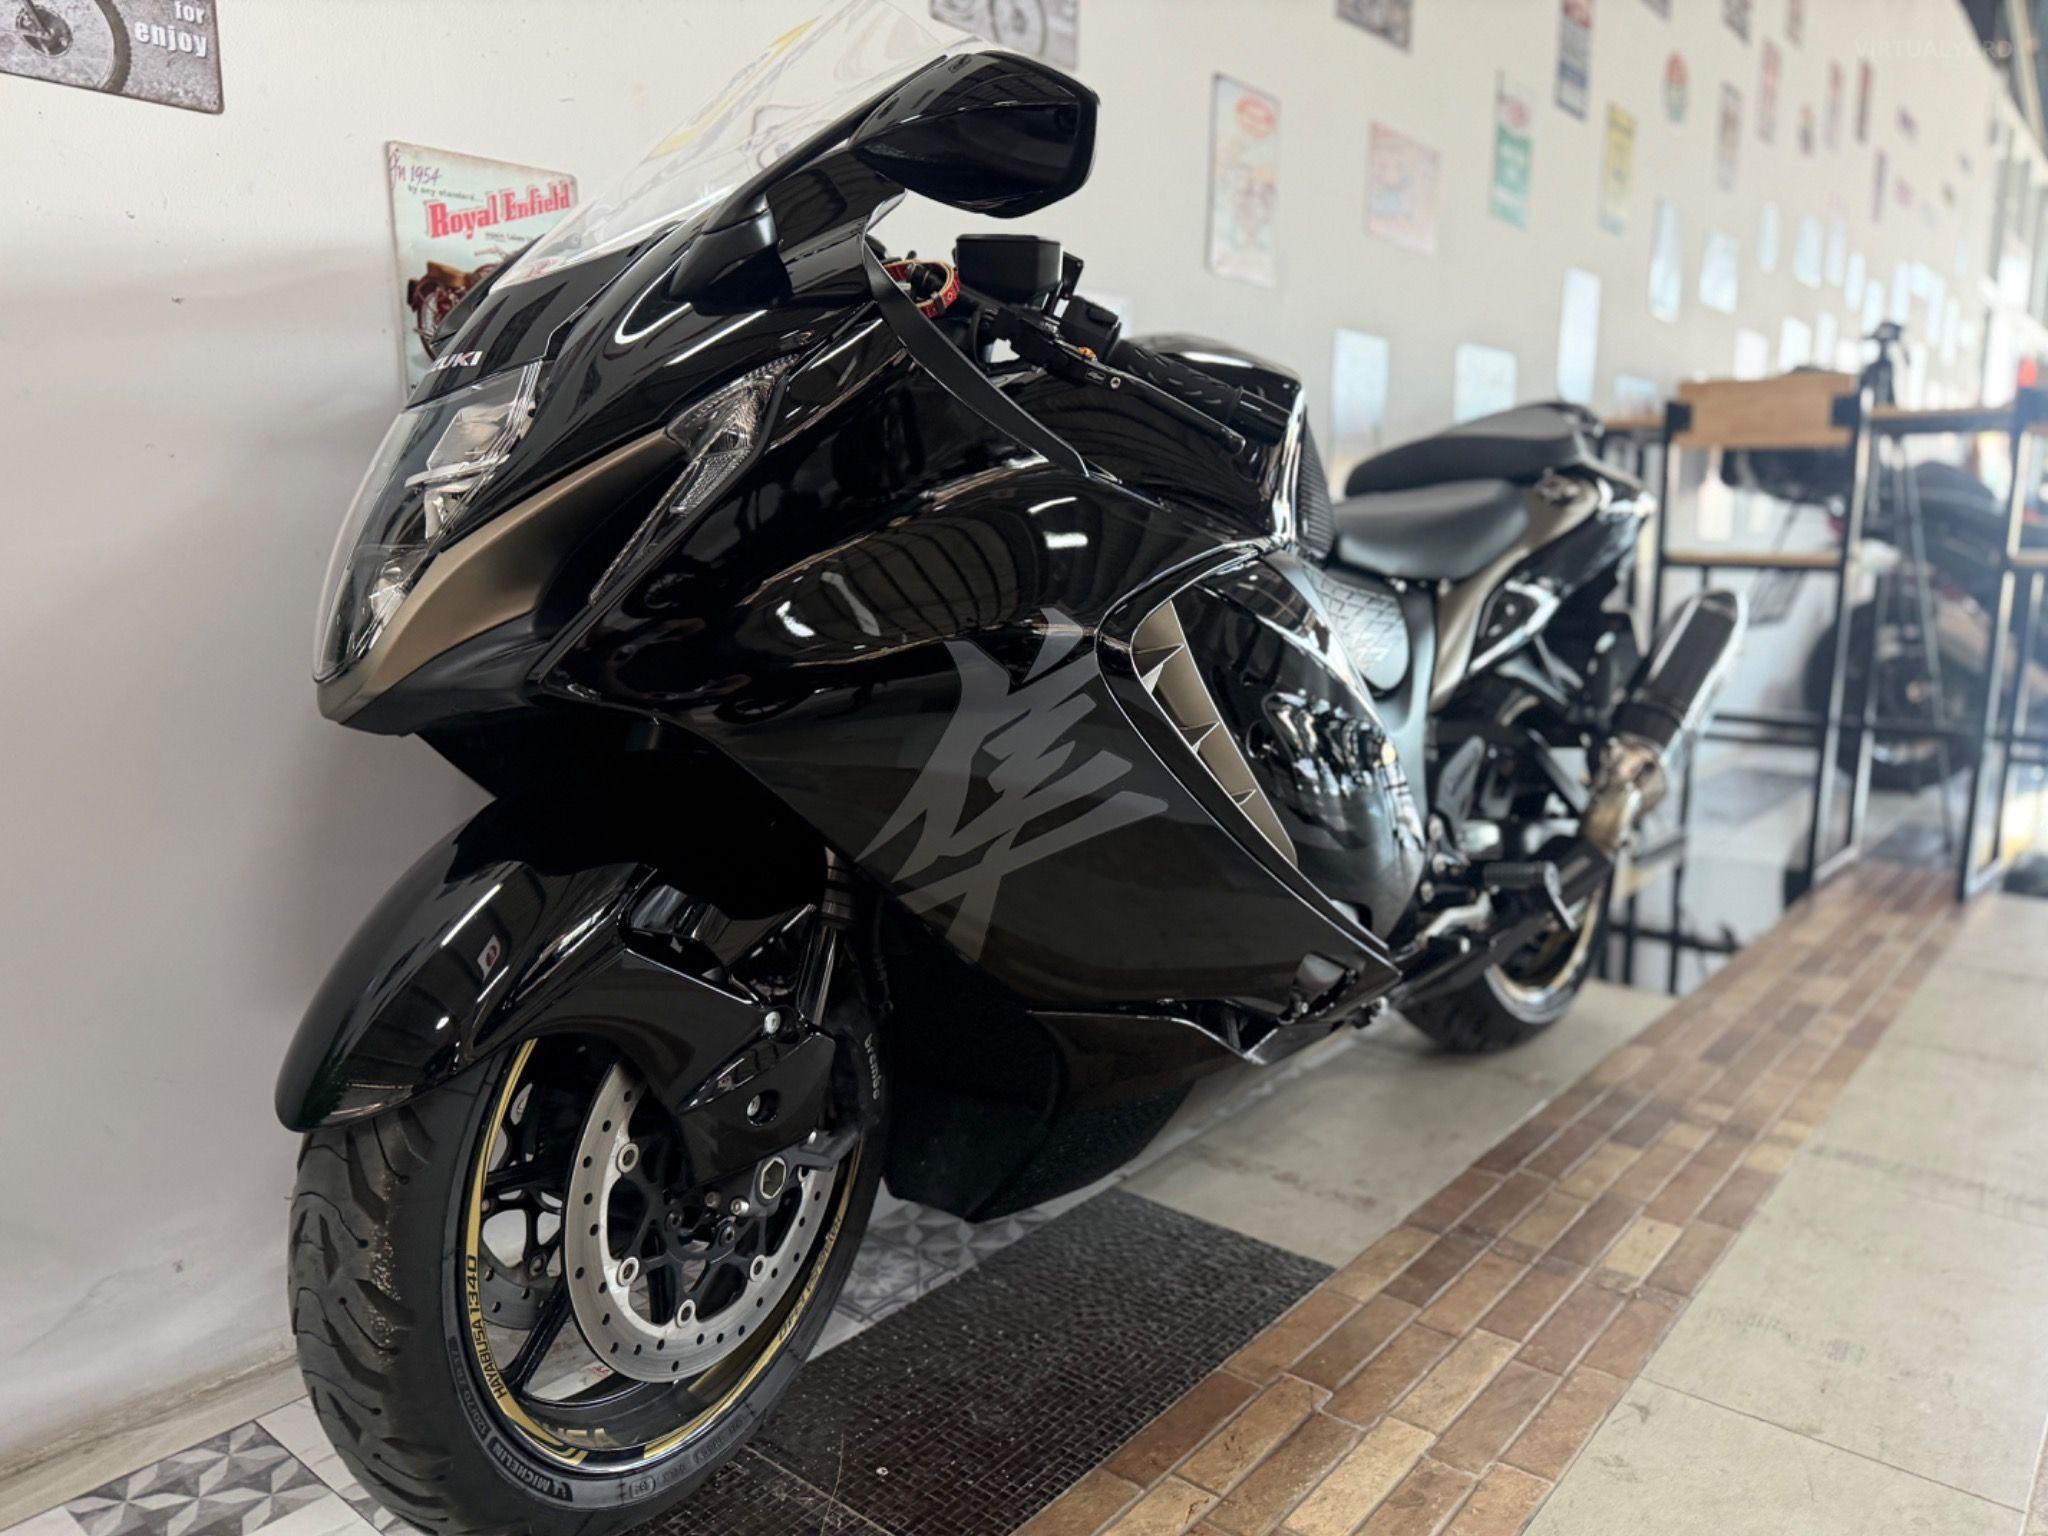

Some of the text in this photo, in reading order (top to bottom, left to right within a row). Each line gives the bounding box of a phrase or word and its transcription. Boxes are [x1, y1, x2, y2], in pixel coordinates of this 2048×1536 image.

[134, 21, 207, 57] enjoy
[174, 0, 205, 24] for
[410, 164, 442, 185] 1954
[426, 182, 571, 240] Royal Enfield
[865, 1032, 882, 1100] brembo
[466, 1254, 508, 1400] HAYABUSA 1340
[493, 1440, 551, 1494] MICHELIN
